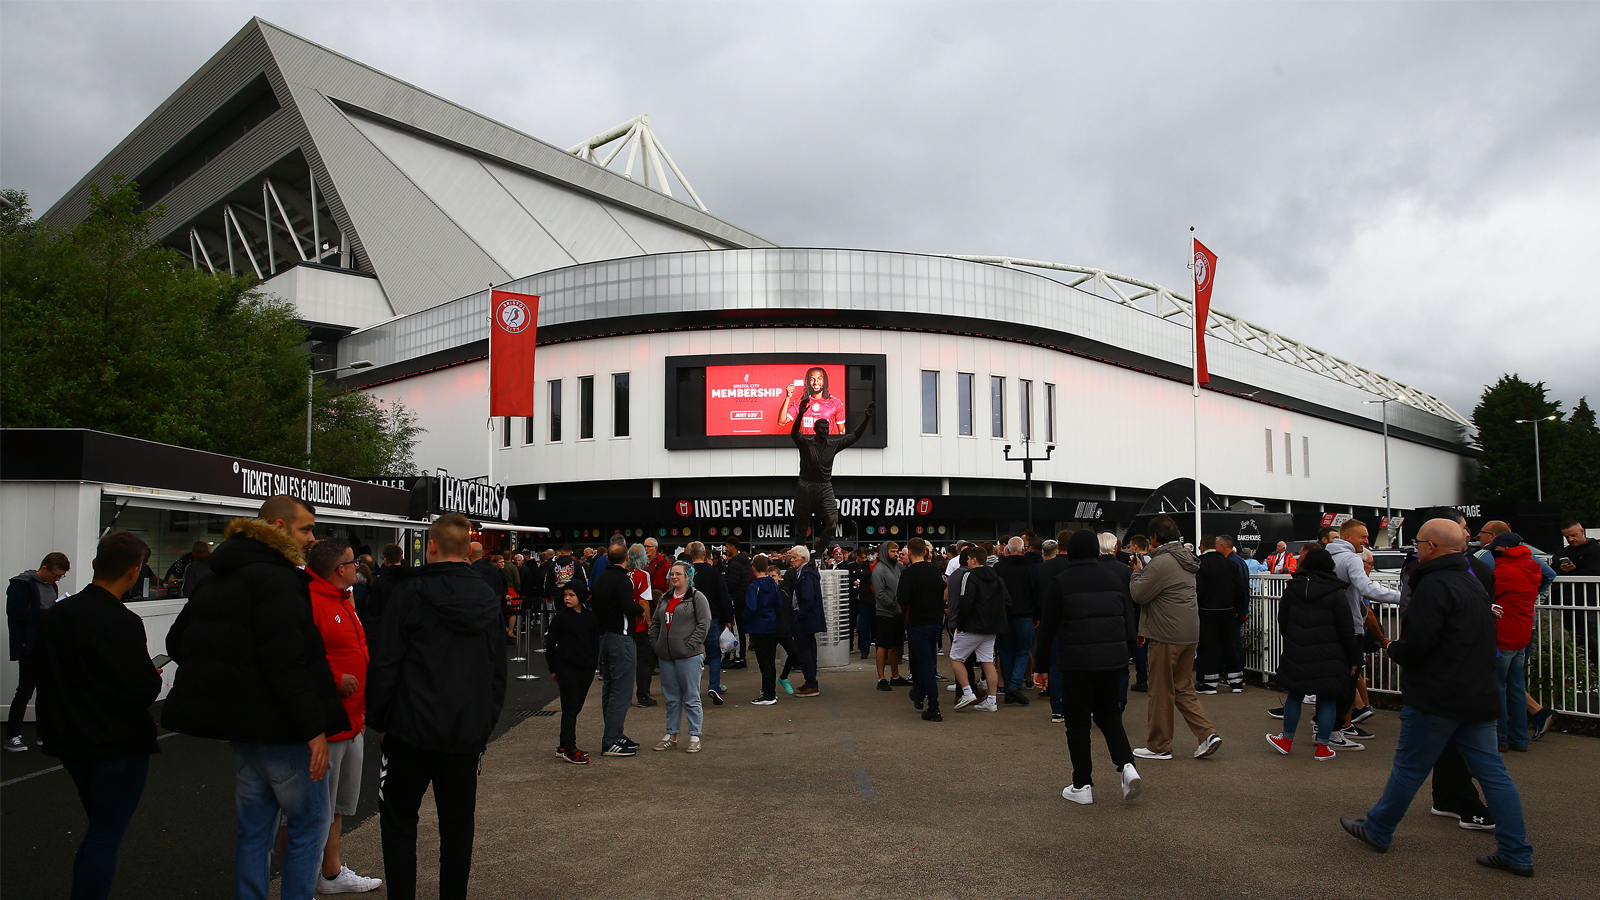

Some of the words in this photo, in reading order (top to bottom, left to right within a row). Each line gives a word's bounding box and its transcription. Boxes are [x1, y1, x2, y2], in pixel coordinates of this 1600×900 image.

[503, 301, 526, 310] BRISTOL
[711, 388, 783, 398] MEMBERSHIP
[241, 468, 272, 497] TICKET
[274, 474, 300, 498] SALES
[300, 479, 307, 501] &
[307, 480, 351, 507] COLLECTIONS
[438, 473, 500, 517] THATCHERS
[694, 499, 795, 518] INDEPENDEN
[833, 498, 881, 517] PORTS
[884, 498, 915, 516] BAR
[757, 524, 790, 538] GAME
